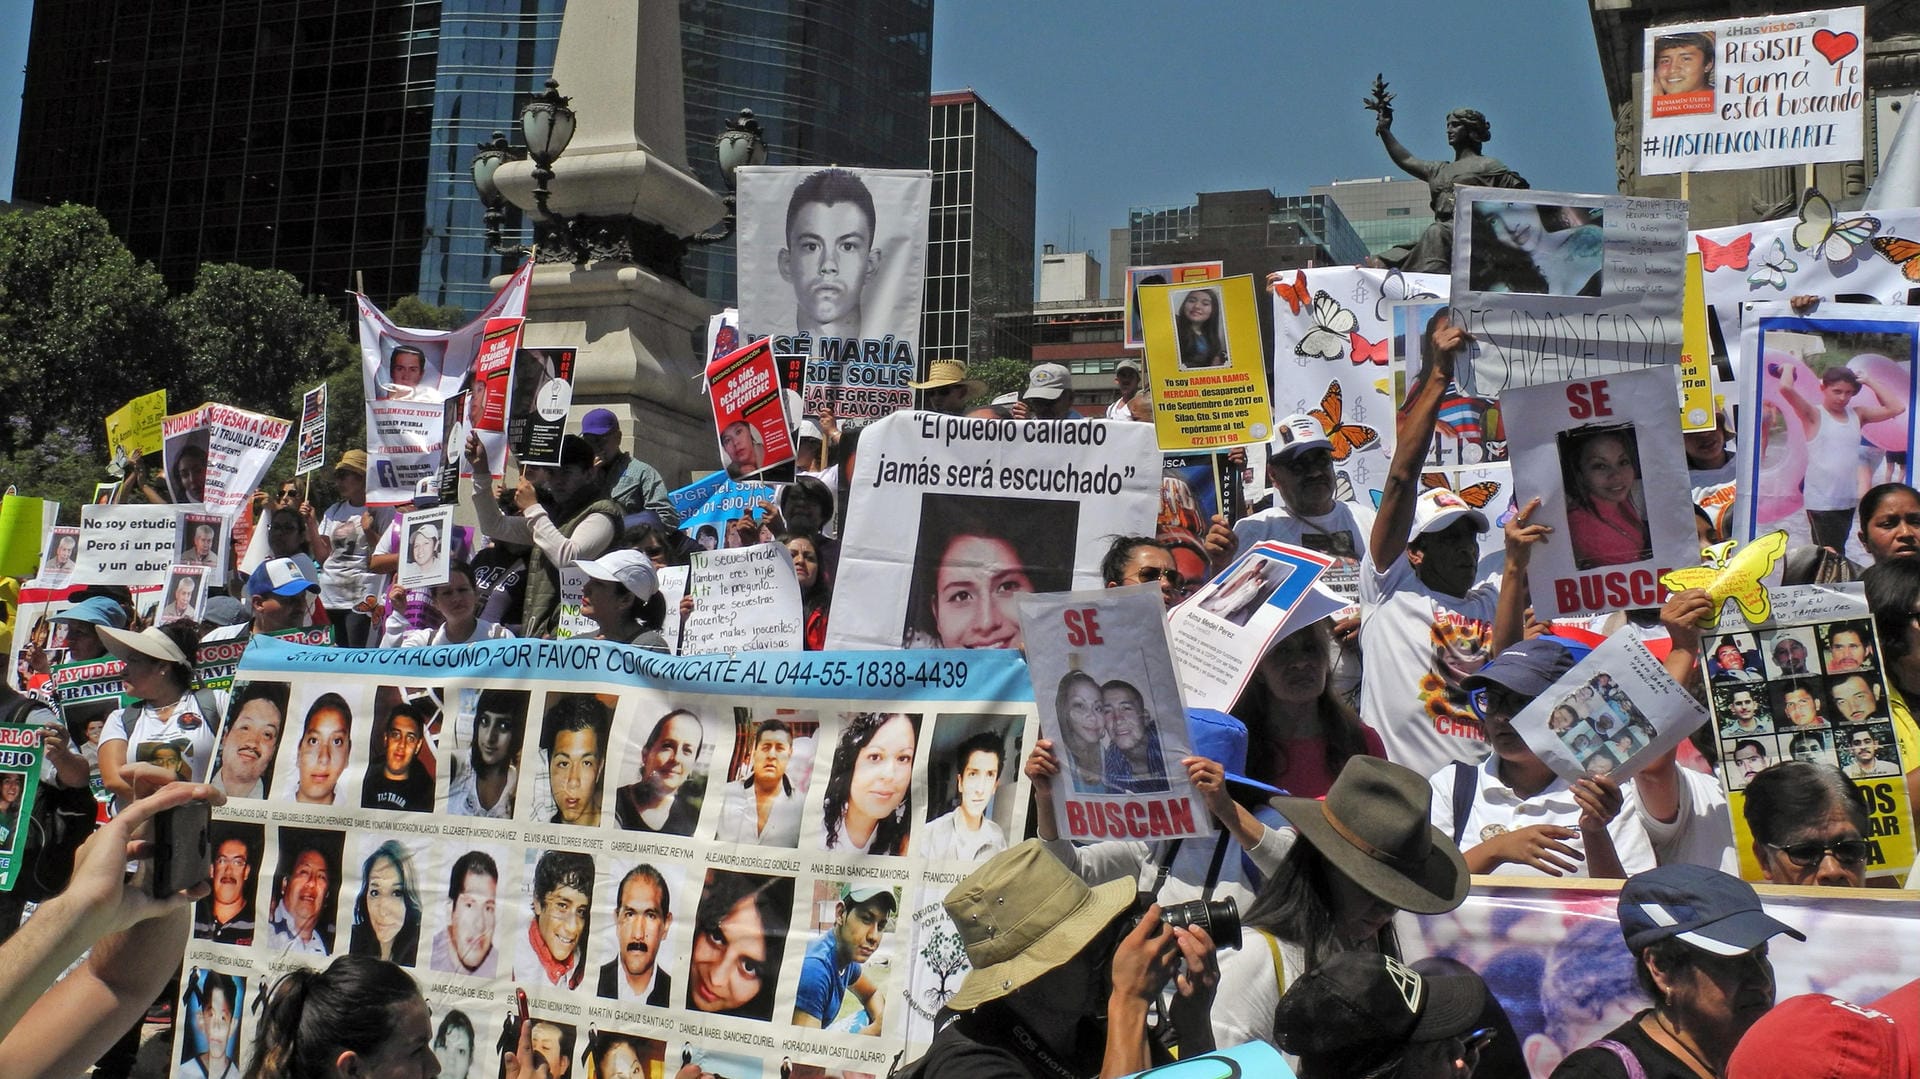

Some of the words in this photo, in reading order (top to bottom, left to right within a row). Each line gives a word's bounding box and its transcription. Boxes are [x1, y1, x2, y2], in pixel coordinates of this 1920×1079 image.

[1725, 35, 1808, 64] RESISTE
[1724, 59, 1811, 95] Mamá
[1829, 60, 1859, 87] te
[1721, 92, 1768, 121] está
[1776, 86, 1863, 117] buscando
[1643, 123, 1839, 159] #HASTAENCONTRARTE
[820, 334, 915, 367] MARÍA
[727, 377, 738, 391] 96
[738, 366, 755, 381] DÍAS
[848, 366, 913, 387] SOLIS
[1688, 366, 1697, 376] el
[720, 369, 770, 407] DESAPARECIDA
[1165, 378, 1175, 388] Yo
[1174, 379, 1190, 389] soy
[1189, 375, 1222, 386] RAMONA
[1222, 373, 1250, 384] RAMOS
[1244, 384, 1254, 394] el
[1694, 379, 1706, 388] en
[726, 402, 736, 415] EN
[736, 381, 770, 410] ECATEPEC
[825, 388, 912, 405] REGRESAR
[1158, 402, 1166, 411] 11
[1166, 401, 1177, 411] de
[1177, 399, 1222, 412] Septiembre
[1223, 398, 1234, 408] de
[1234, 397, 1252, 407] 2017
[1253, 396, 1264, 404] en
[1566, 380, 1613, 419] SE
[1212, 411, 1221, 420] Si
[1221, 411, 1234, 420] me
[1235, 409, 1249, 418] ves
[164, 411, 200, 437] AYUDAME
[1181, 423, 1223, 435] repórtame
[1223, 422, 1231, 431] al
[220, 428, 254, 448] TRUJILLO
[946, 419, 1017, 447] pueblo
[1023, 419, 1107, 446] callado
[1191, 436, 1204, 446] 472
[1205, 435, 1218, 445] 101
[1219, 435, 1227, 444] 11
[1227, 433, 1239, 443] 98
[872, 453, 940, 488] jamás
[945, 458, 994, 489] será
[673, 487, 708, 505] PGR
[712, 479, 733, 496] Tel.
[407, 510, 448, 522] Desaparecido
[84, 518, 102, 529] No
[105, 520, 127, 532] soy
[86, 540, 117, 551] Pero
[119, 540, 130, 551] si
[98, 562, 107, 573] y
[110, 562, 127, 571] un
[729, 568, 749, 579] eres
[754, 564, 776, 580] hij@
[561, 572, 583, 586] Las
[702, 584, 712, 596] ti
[720, 582, 729, 596] te
[1793, 590, 1806, 599] EL
[562, 603, 581, 616] NO
[696, 598, 709, 612] Por
[711, 601, 726, 615] que
[731, 595, 775, 609] secuestras
[1807, 597, 1825, 606] EN
[560, 616, 570, 626] la
[690, 611, 738, 628] inocentes?
[1063, 607, 1105, 647] SE
[1201, 616, 1219, 633] Medel
[1219, 624, 1236, 640] Perez
[558, 628, 572, 638] No
[701, 633, 714, 645] que
[720, 626, 747, 639] matas
[742, 638, 791, 652] esclavisas
[489, 643, 532, 669] POR
[537, 644, 602, 671] FAVOR
[606, 649, 741, 684] COMUNICATE
[740, 661, 769, 685] AL
[774, 659, 969, 690] 044-55-1838-4439
[1064, 797, 1197, 840] BUSCAN
[442, 825, 473, 837] ELIZABETH
[473, 828, 494, 839] MORENO
[523, 833, 541, 844] ELVIS
[560, 836, 583, 848] TORRES
[583, 838, 604, 850] ROSETE
[610, 841, 639, 852] GABRIELA
[639, 842, 668, 857] MARTÍNEZ
[669, 847, 694, 860] REYNA
[704, 852, 741, 867] ALEJANDRO
[741, 855, 771, 870] RODRÍGUEZ
[771, 858, 801, 872] GONZÁLEZ
[810, 863, 824, 874] ANA
[824, 864, 846, 875] BELEM
[846, 864, 880, 879] SÁNCHEZ
[879, 869, 910, 880] MAYORGA
[922, 871, 955, 884] FRANCISCO
[430, 983, 449, 993] JAIME
[467, 988, 476, 998] DE
[562, 1002, 582, 1016] OROZCO
[588, 1006, 613, 1019] MARTÍN
[613, 1010, 642, 1024] GACHUZ
[641, 1014, 675, 1030] SANTIAGO
[679, 1022, 704, 1036] DANIELA
[704, 1026, 723, 1041] MABEL
[722, 1029, 753, 1045] SANCHEZ
[752, 1035, 776, 1048] CURIEL
[1012, 1025, 1038, 1051] EOS
[782, 1039, 811, 1053] HORACIO
[811, 1042, 829, 1056] ALAIN
[828, 1045, 860, 1060] CASTILLO
[859, 1050, 887, 1064] ALFARO
